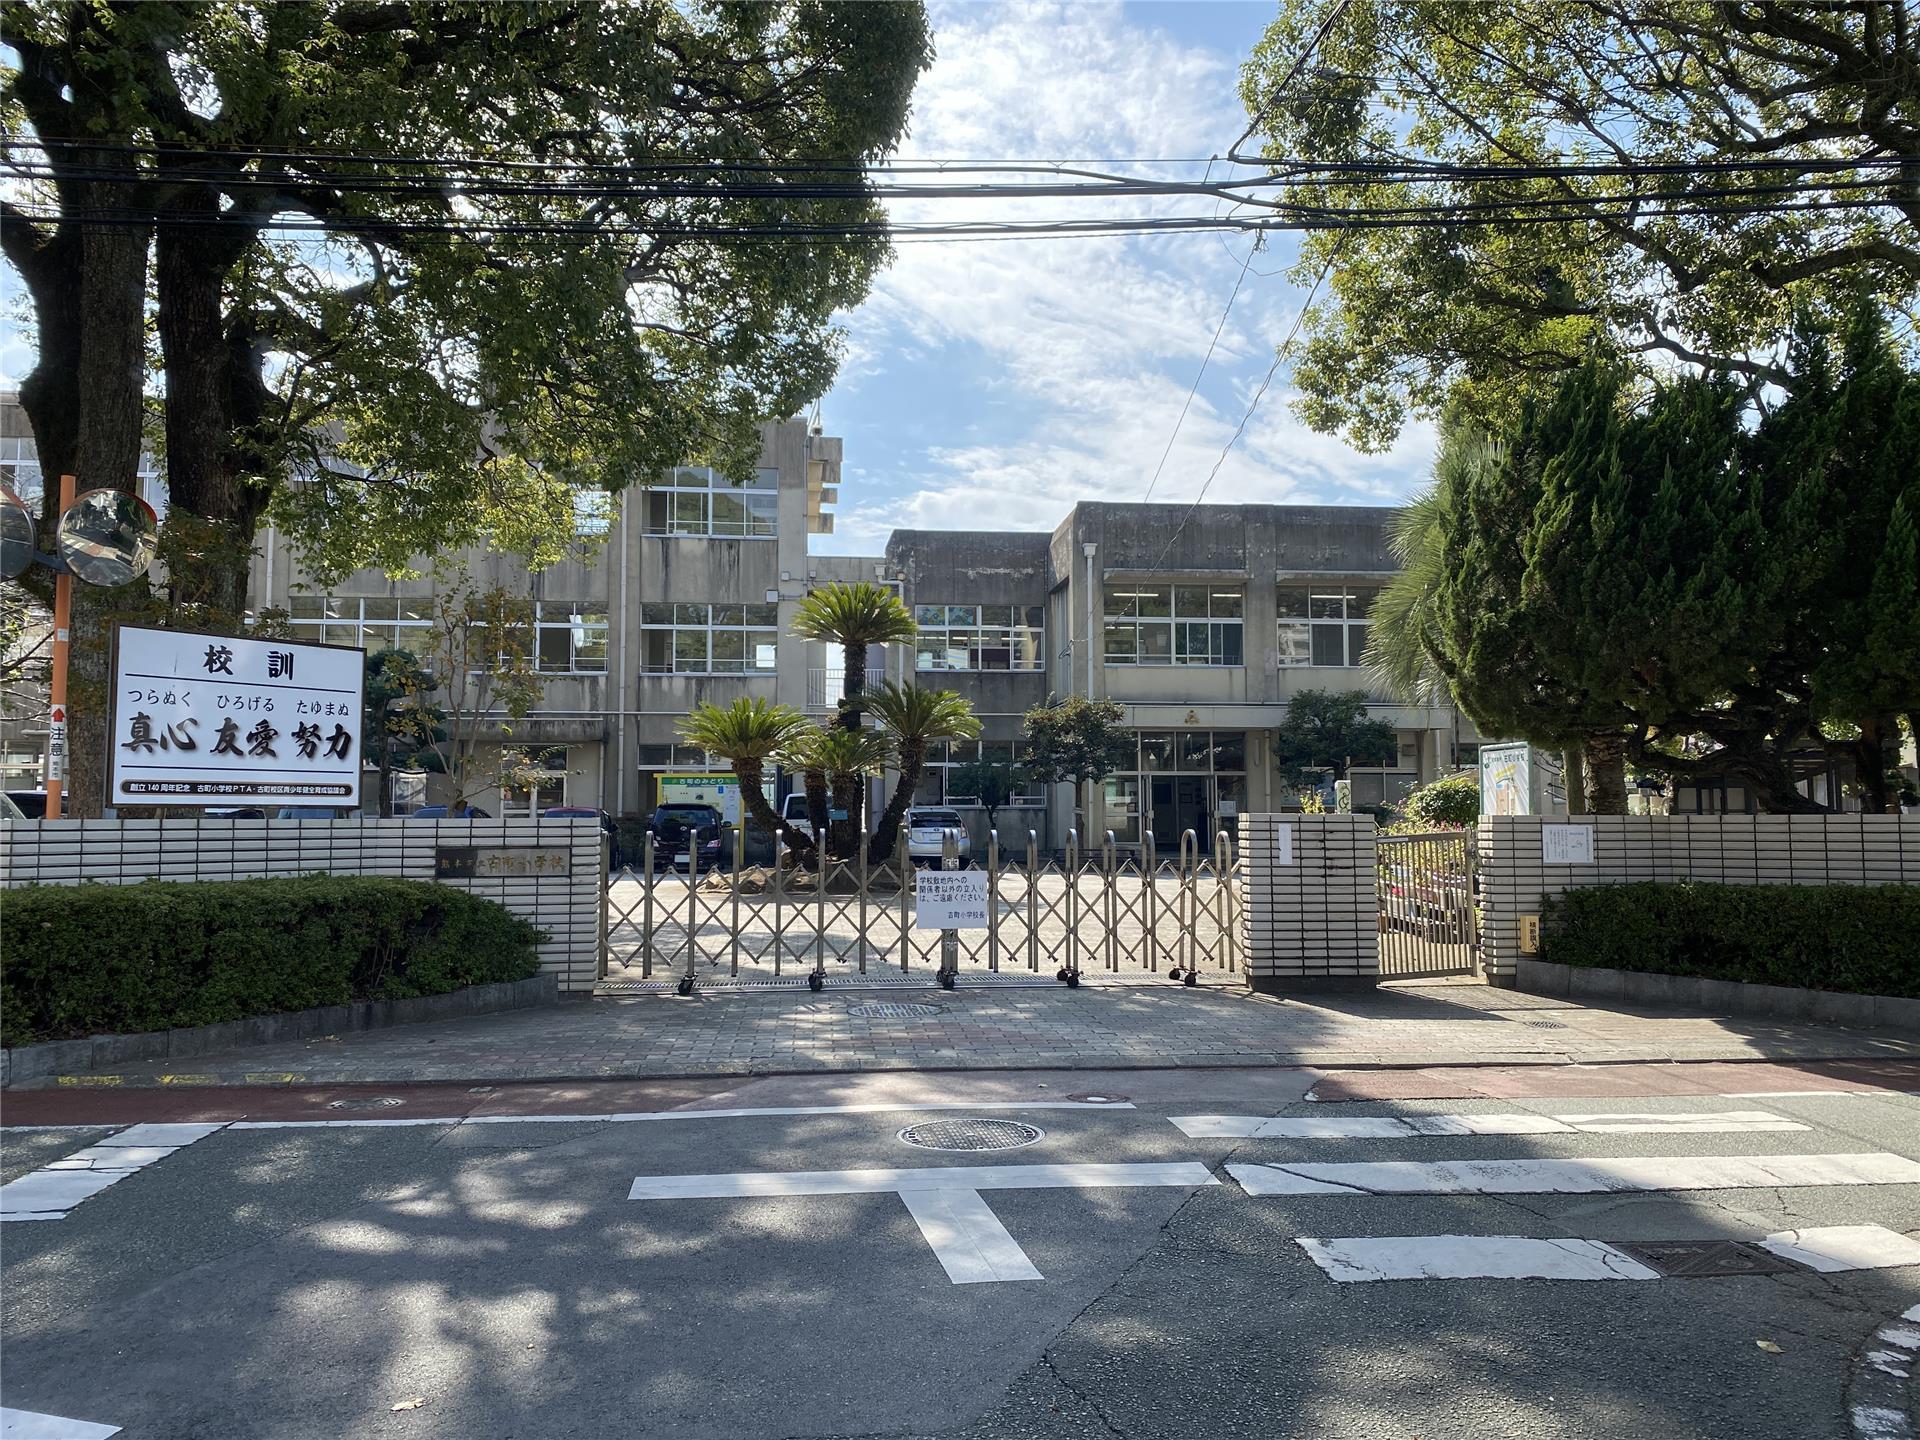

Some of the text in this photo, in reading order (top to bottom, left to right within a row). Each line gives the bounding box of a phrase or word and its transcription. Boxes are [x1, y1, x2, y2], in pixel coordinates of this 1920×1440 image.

[203, 644, 295, 681] 校訓
[128, 688, 349, 717] つらぬく ひろげる たゆまぬ
[50, 727, 65, 756] 注意
[121, 711, 352, 760] 真心 友愛 努力
[919, 885, 984, 894] 関係者以外の立入り
[920, 876, 968, 884] 学校敷地内への
